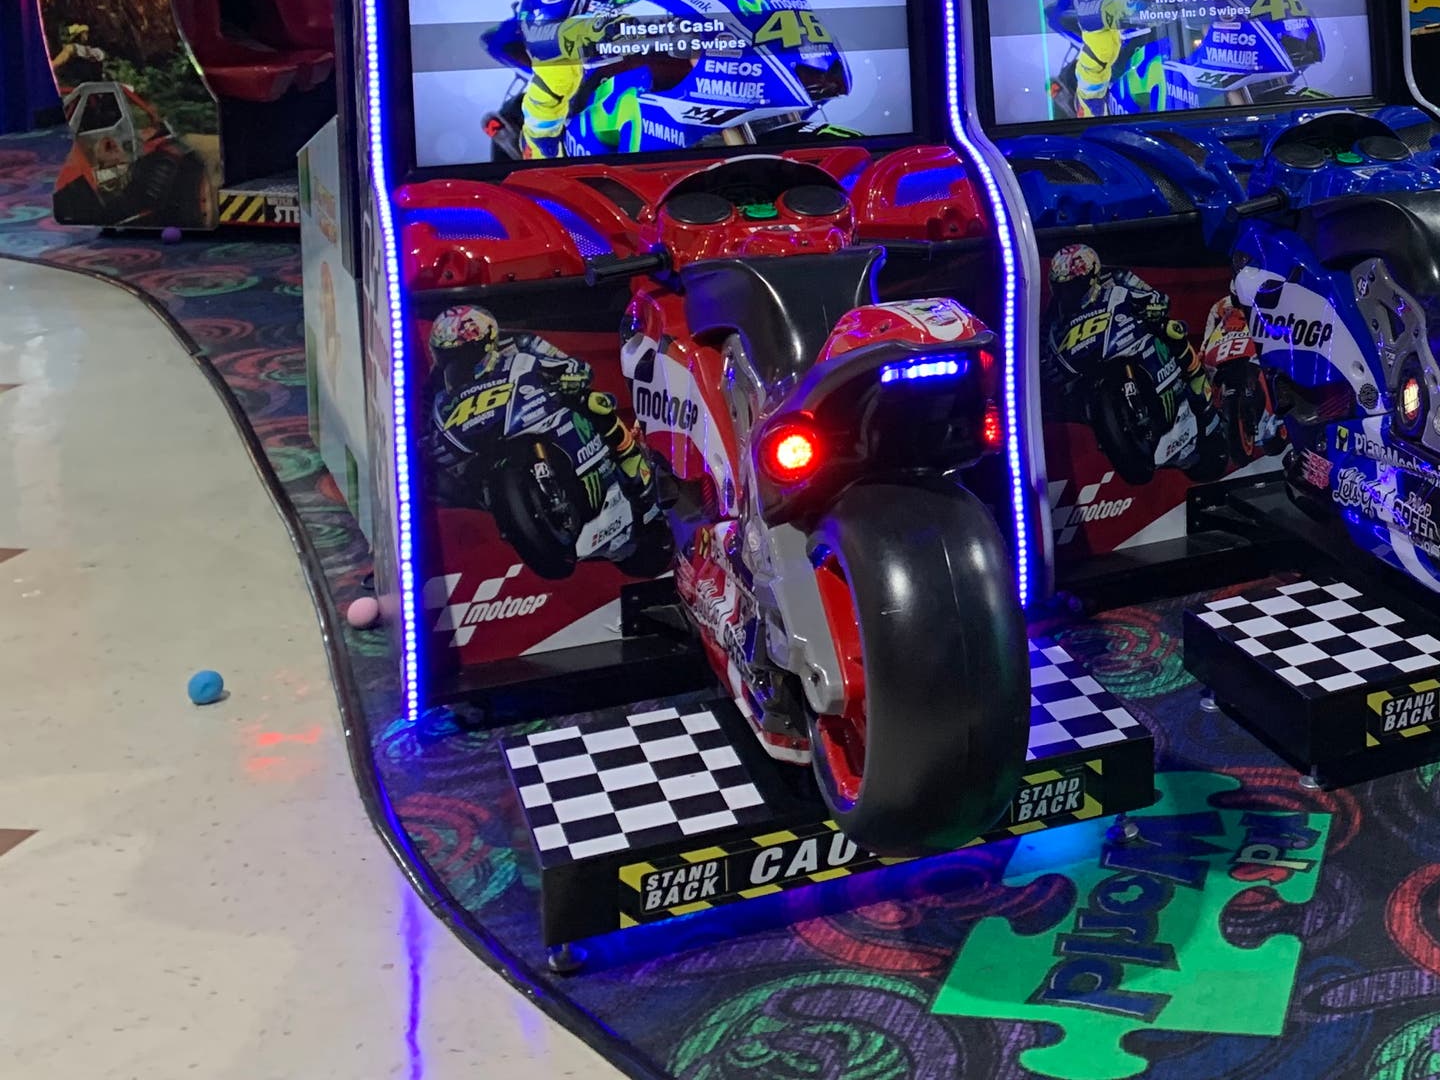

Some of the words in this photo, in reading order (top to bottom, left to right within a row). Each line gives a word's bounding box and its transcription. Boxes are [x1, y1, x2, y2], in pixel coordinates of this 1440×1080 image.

[1139, 11, 1178, 21] Money
[1181, 9, 1196, 18] In:
[1211, 6, 1251, 16] Swipes
[620, 21, 675, 36] Insert
[680, 20, 725, 33] Cash
[755, 10, 832, 48] 46
[1212, 31, 1257, 46] ENEOS
[599, 43, 650, 56] Money
[655, 42, 673, 53] In:
[691, 38, 747, 51] Swipes
[1205, 46, 1258, 66] YAMALUBE
[704, 60, 763, 77] ENEOS
[696, 77, 765, 99] YAMALUBE
[1166, 82, 1199, 107] YAMAHA
[641, 119, 687, 148] YAMAHA
[1058, 312, 1112, 352] 46
[444, 383, 513, 430] 46
[1385, 692, 1434, 716] STAND
[1385, 705, 1434, 730] BACK
[1018, 778, 1078, 801] STAND
[1018, 792, 1080, 821] BACK
[645, 861, 717, 888] STAND
[645, 879, 716, 909] BACK
